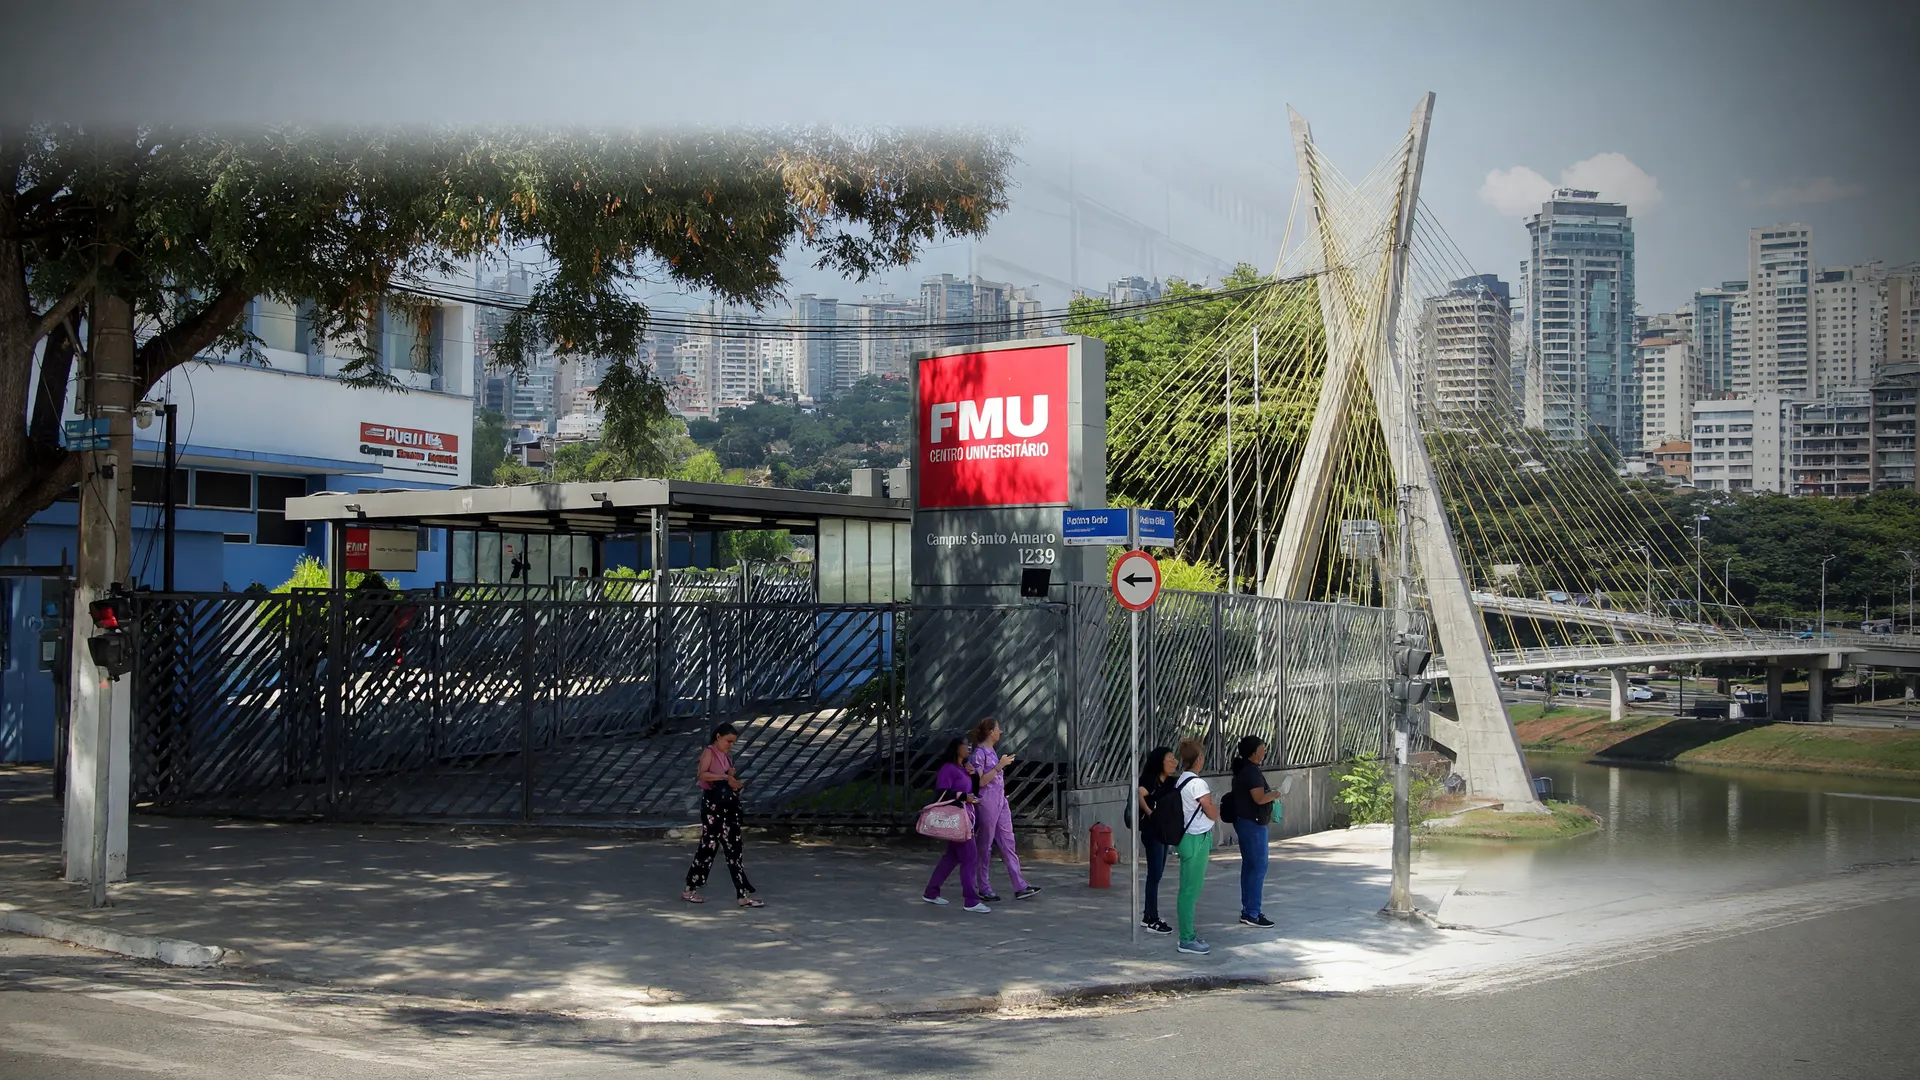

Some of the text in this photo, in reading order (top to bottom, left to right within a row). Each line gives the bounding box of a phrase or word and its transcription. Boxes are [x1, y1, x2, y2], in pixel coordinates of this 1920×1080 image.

[930, 395, 1049, 444] FMU
[930, 440, 1049, 462] CENTRO UNIVERSITÁRIO
[926, 532, 968, 548] Campus
[970, 531, 1007, 545] Santo
[1011, 531, 1055, 544] Amaro
[1018, 548, 1056, 565] 1239
